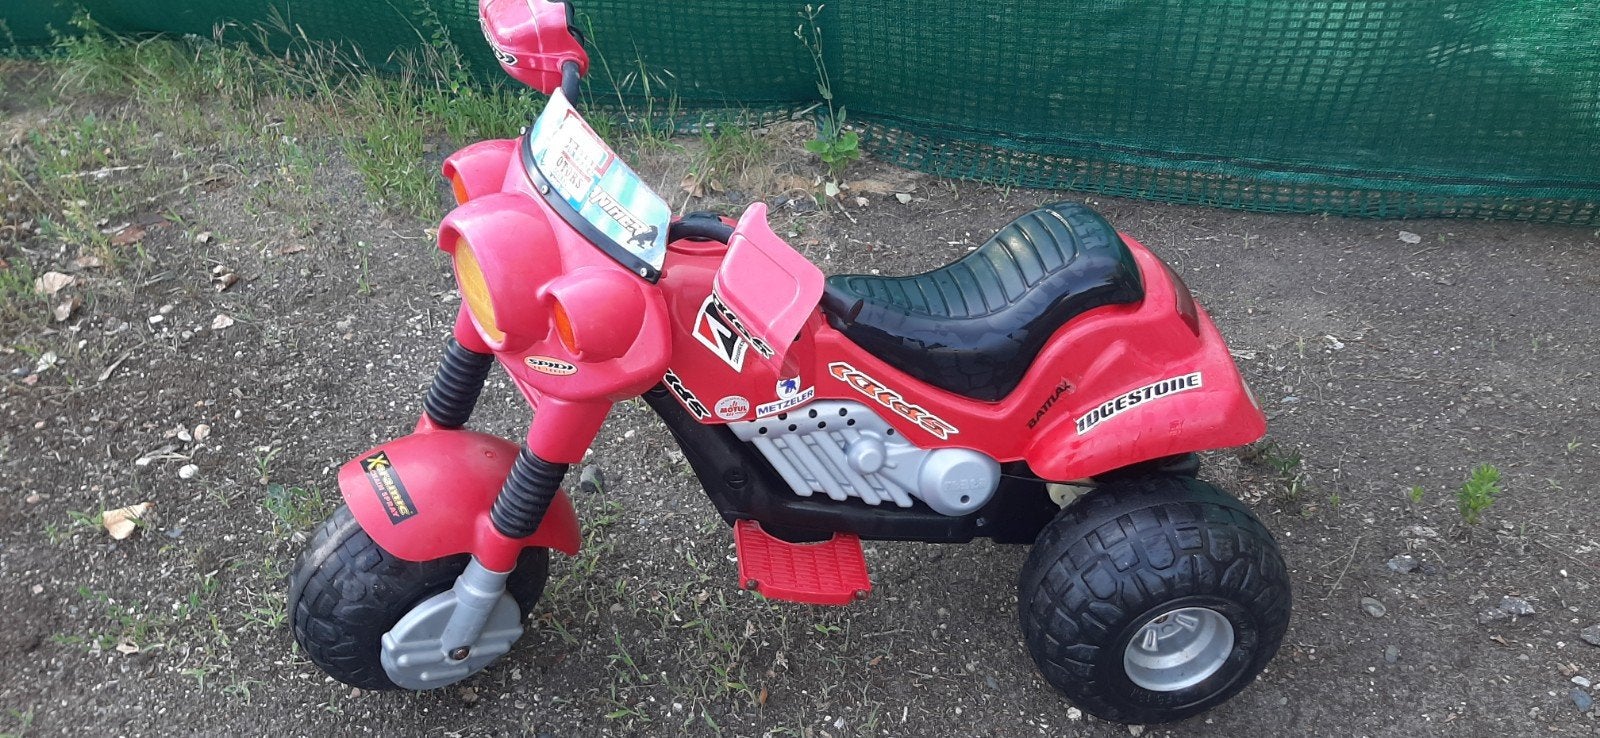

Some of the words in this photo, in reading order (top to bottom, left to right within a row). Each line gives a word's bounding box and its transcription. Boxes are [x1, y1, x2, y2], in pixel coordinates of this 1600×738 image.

[720, 405, 747, 413] MOTUL
[758, 389, 814, 415] METZELER
[370, 469, 384, 490] CHAIN
[381, 491, 400, 516] SPRAY
